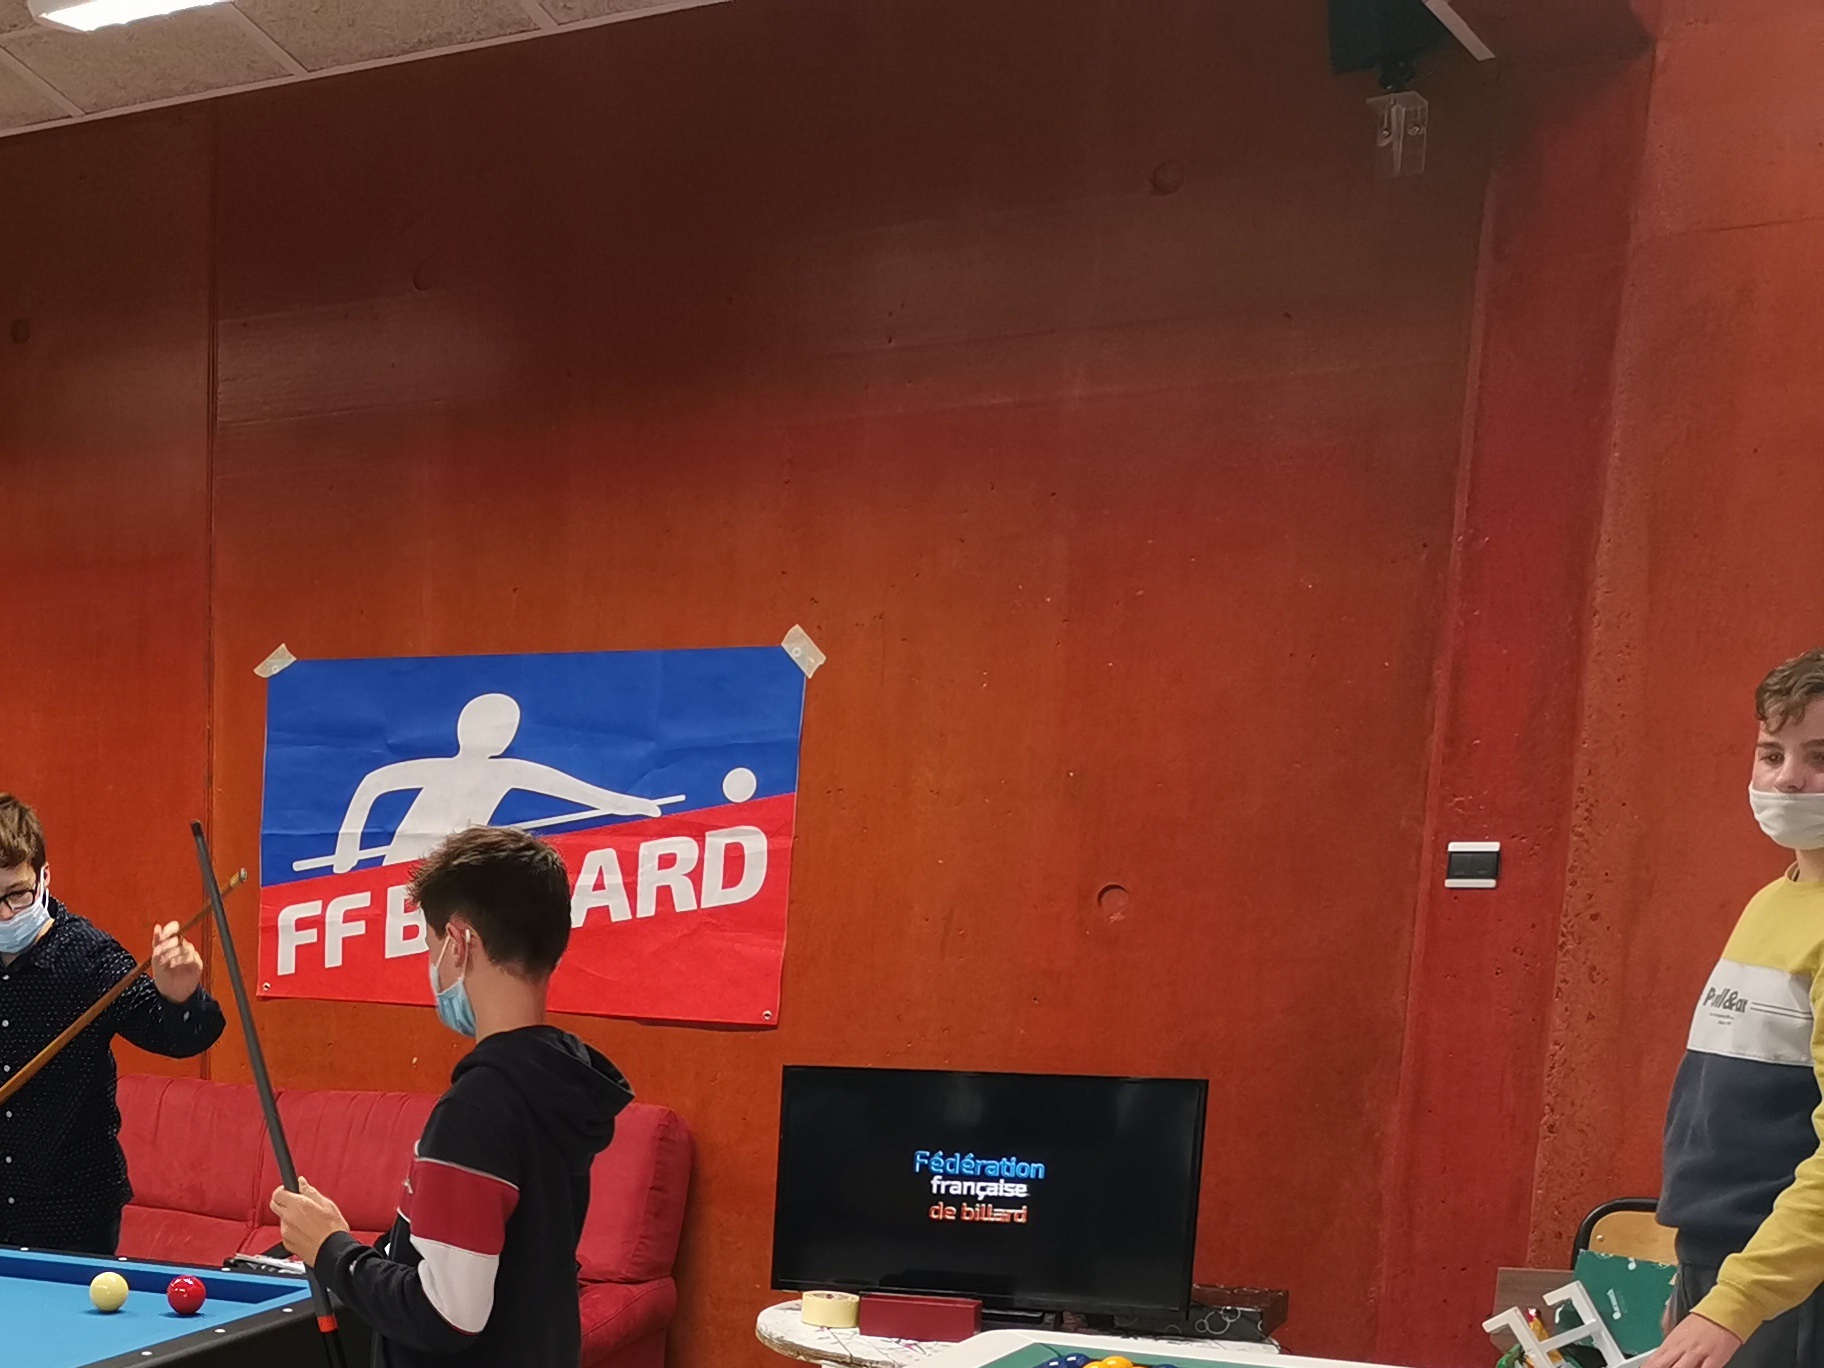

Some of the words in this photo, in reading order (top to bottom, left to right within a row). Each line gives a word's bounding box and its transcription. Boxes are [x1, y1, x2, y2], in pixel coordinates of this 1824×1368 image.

[277, 891, 372, 976] FF
[384, 825, 768, 959] BARD
[914, 1150, 1045, 1179] Fédération
[930, 1175, 1030, 1201] française
[929, 1201, 957, 1220] de
[961, 1202, 1028, 1224] billard
